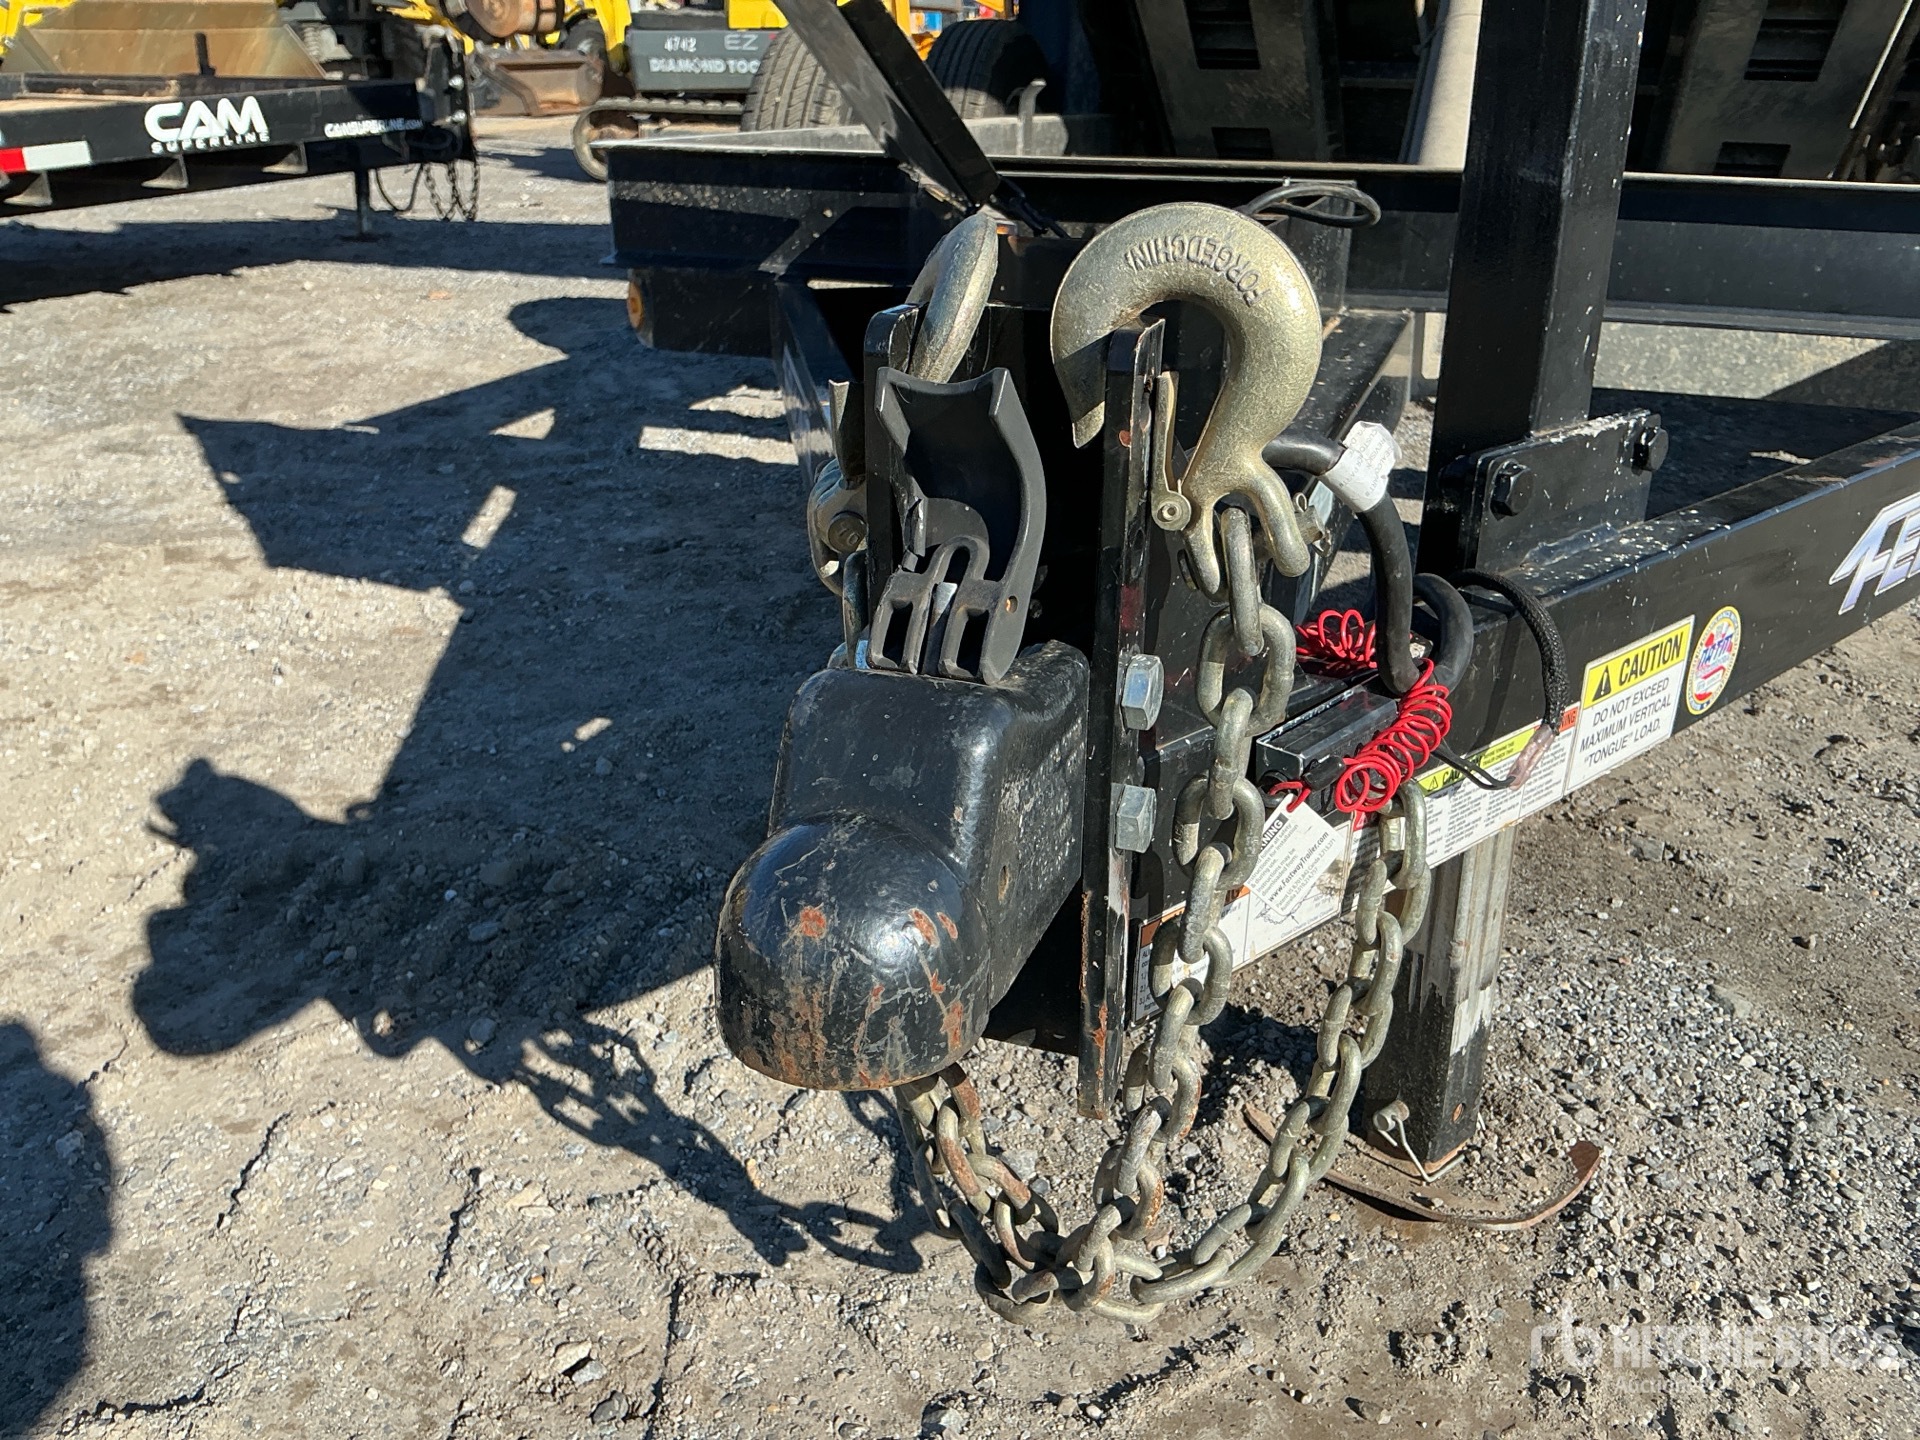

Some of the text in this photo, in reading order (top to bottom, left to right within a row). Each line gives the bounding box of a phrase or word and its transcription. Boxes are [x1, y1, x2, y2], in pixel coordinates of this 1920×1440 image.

[648, 57, 727, 74] DIAMOND
[144, 95, 269, 142] CAM
[150, 131, 270, 154] SUPERLINE
[1618, 632, 1684, 686] CAUTION
[1579, 720, 1627, 753] MAXIMUM
[1629, 694, 1672, 724] VERTICAL
[1593, 706, 1609, 727] DO
[1609, 698, 1629, 720] NOT
[1632, 677, 1670, 707] EXCEED
[1634, 718, 1661, 742] LOAD.
[1277, 823, 1292, 839] safety
[1266, 830, 1330, 903] www.FastwayTrailer.com
